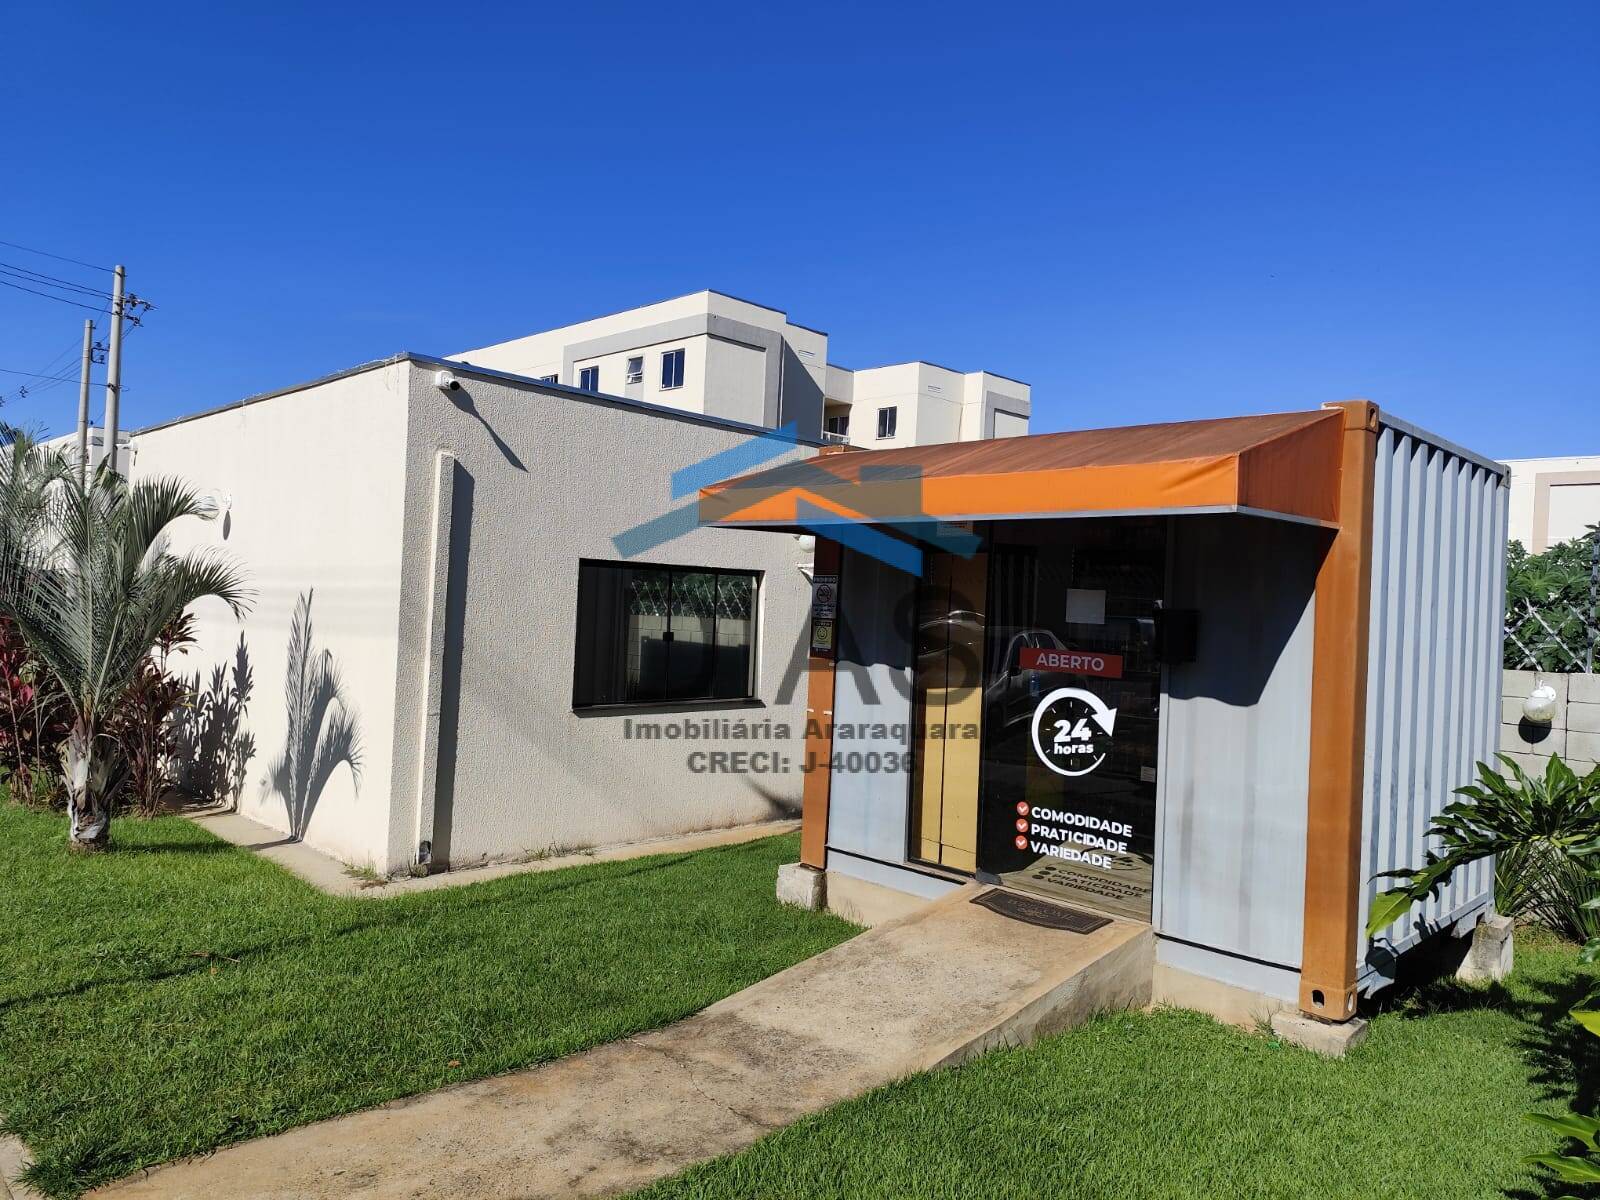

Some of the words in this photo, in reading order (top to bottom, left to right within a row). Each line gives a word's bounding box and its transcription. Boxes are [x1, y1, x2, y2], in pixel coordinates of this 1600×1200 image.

[1036, 653, 1105, 671] ABERTO
[1053, 718, 1092, 743] 24
[1053, 743, 1094, 755] horas
[1031, 806, 1133, 838] COMODIDADE
[1030, 823, 1128, 855] PRATICIDADE
[1030, 840, 1112, 869] VARIEDADE
